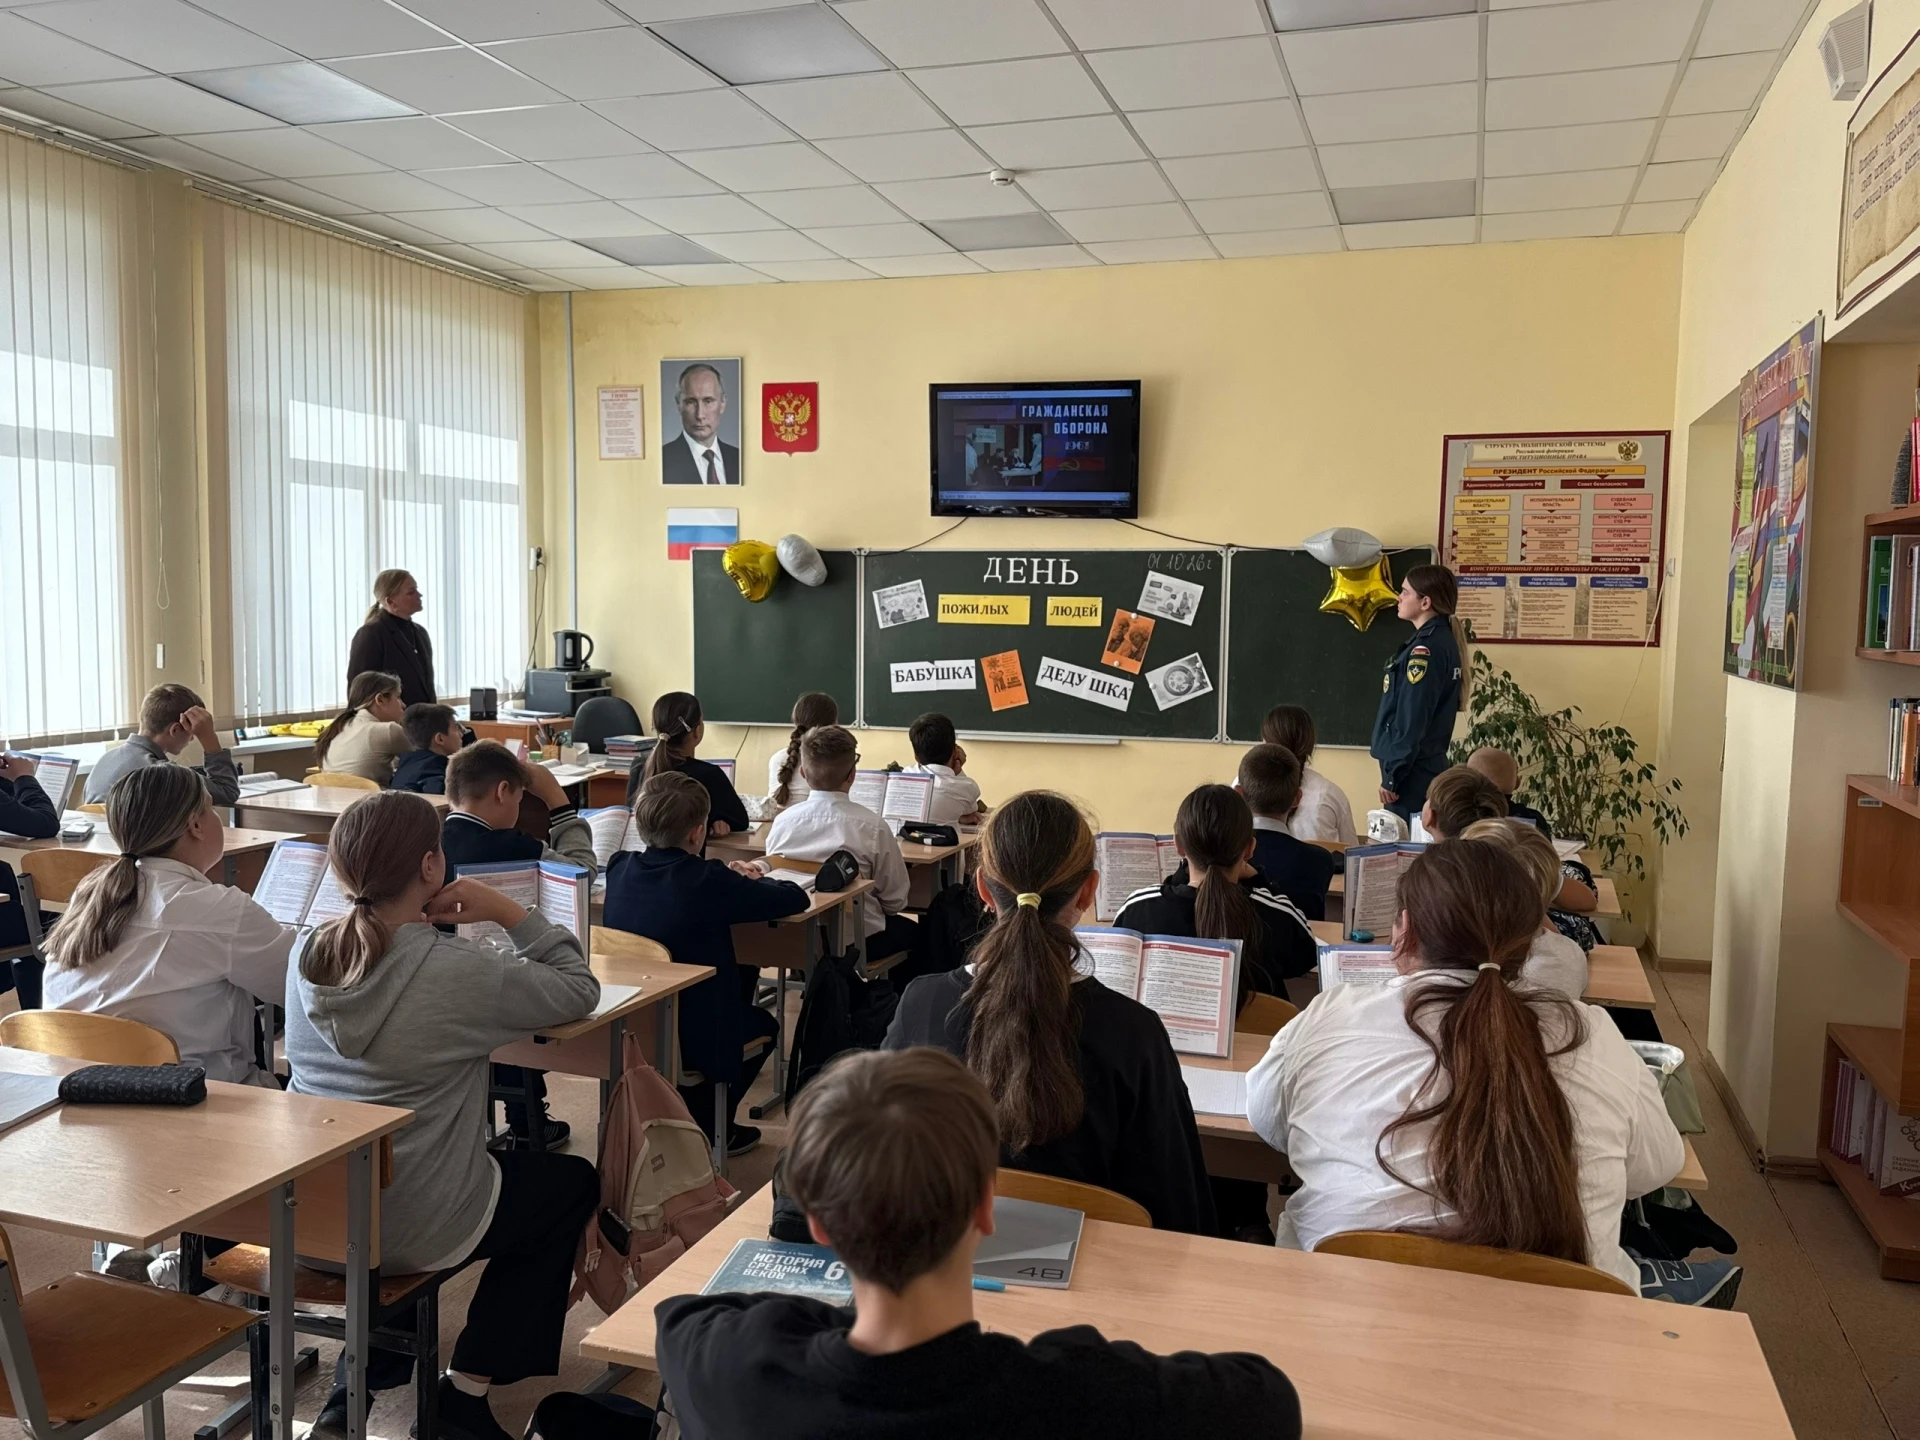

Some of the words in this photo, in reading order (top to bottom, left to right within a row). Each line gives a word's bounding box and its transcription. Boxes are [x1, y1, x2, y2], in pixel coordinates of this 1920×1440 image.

[1022, 404, 1109, 418] ГРАЖДАНСКАЯ
[1053, 422, 1108, 434] ОБОРОНА
[1166, 552, 1184, 571] 10
[984, 557, 1080, 585] ДЕНЬ
[942, 604, 1009, 615] ПОЖИЛЫХ
[1050, 604, 1098, 618] ЛЮДЕЙ
[894, 666, 973, 682] БАБУШКА
[752, 1252, 826, 1269] ИСТОРИЯ
[742, 1268, 786, 1280] ВЕКОВ
[748, 1261, 809, 1275] СРЕДНИХ
[824, 1260, 846, 1280] 6
[1016, 1266, 1065, 1280] 48
